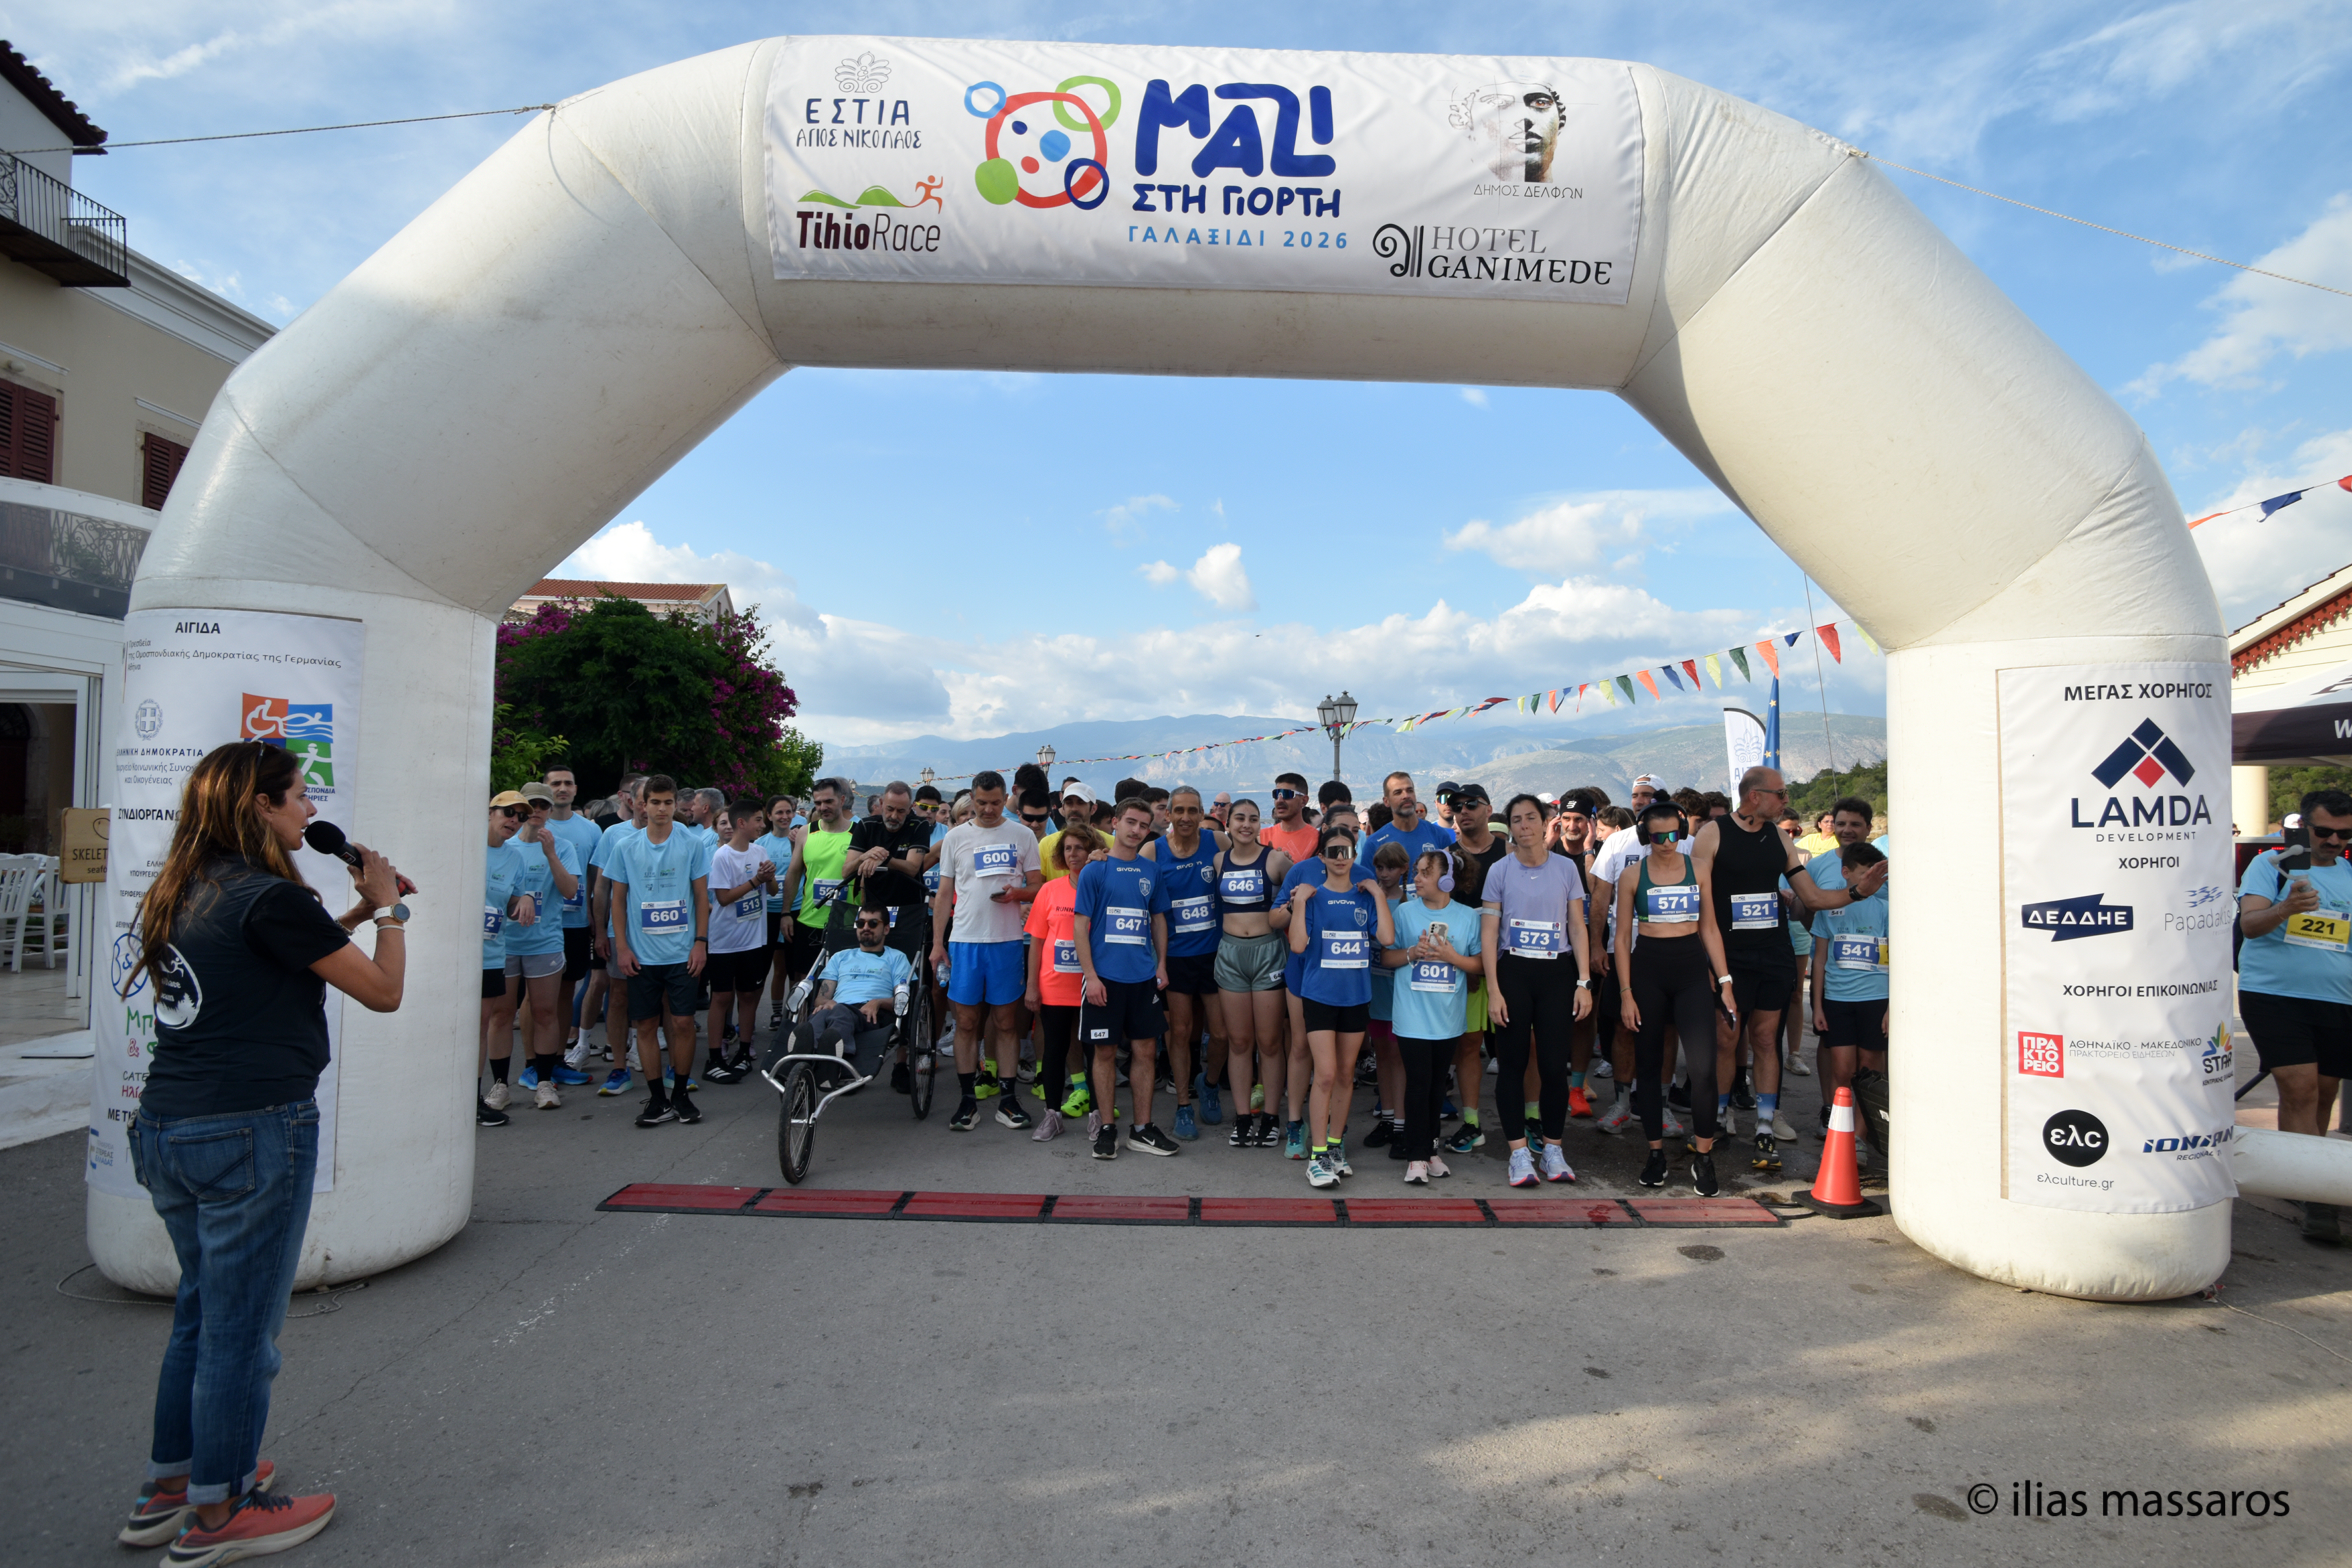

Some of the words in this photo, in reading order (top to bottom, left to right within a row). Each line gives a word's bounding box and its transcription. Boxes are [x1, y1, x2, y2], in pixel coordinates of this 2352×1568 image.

[805, 98, 910, 126] ΕΣΤΙΑ
[796, 128, 838, 147] ΑΓΙΟΣ
[844, 129, 922, 149] ΝΙΚΟΛΑΟΣ
[1473, 184, 1520, 198] ΔΗΜΟΣ
[1524, 185, 1583, 200] ΔΕΛΦΩΝ
[1131, 184, 1206, 214] ΣΤΗ
[1221, 186, 1341, 218] ΓΙΟΡΤΗ
[796, 210, 941, 252] TihioRace
[1129, 226, 1265, 246] ΓΑΛΑΞΙΔΙ
[1283, 230, 1348, 250] 2026
[1432, 226, 1547, 254] HOTEL
[1428, 255, 1612, 286] GANIMEDE
[175, 621, 221, 634] ΑΙΓΙΔΑ
[135, 649, 191, 659] Ομοσπονδιακής
[193, 649, 260, 662] Δημοκρατίας
[262, 655, 281, 663] της
[285, 654, 342, 668] Γερμανίας
[2063, 684, 2133, 701] ΜΕΓΑΣ
[2138, 682, 2213, 700] ΧΟΡΗΓΟΣ
[141, 747, 204, 757] ΔΗΜΟΚΡΑΤΙΑ
[133, 774, 173, 785] Οικογένειας
[2071, 793, 2213, 828] LAMDA
[2096, 831, 2197, 842] DEVELOPMENT
[72, 848, 109, 861] SKELET
[982, 852, 1010, 864] 600
[87, 865, 108, 874] seafo
[2118, 856, 2180, 869] ΧΟΡΗΓΟΙ
[1228, 880, 1255, 892] 646
[742, 898, 761, 911] 513
[1658, 896, 1688, 909] 571
[1742, 903, 1769, 916] 521
[651, 910, 679, 922] 660
[1182, 905, 1209, 920] 648
[2027, 909, 2128, 925] ΔΕΔΔΗΕ
[1115, 917, 1142, 931] 647
[2165, 905, 2231, 935] Papadakis
[2300, 918, 2335, 935] 221
[1519, 931, 1550, 945] 573
[1061, 949, 1078, 961] 61
[1331, 941, 1361, 955] 644
[1842, 943, 1870, 957] 541
[1420, 965, 1449, 978] 601
[2063, 984, 2132, 998] ΧΟΡΗΓΟΙ
[2136, 979, 2219, 998] ΕΠΙΚΟΙΝΩΝΙΑΣ
[2023, 1036, 2059, 1050] ΠΡΑ
[2069, 1040, 2131, 1050] ΑΘΗΝΑΪΚΟ
[2141, 1038, 2202, 1050] ΜΑΚΕΔΟΝΙΚΟ
[2023, 1048, 2059, 1061] ΚΤΟ
[2069, 1050, 2130, 1059] ΠΡΑΚΤΟΡΕΙΟ
[2132, 1050, 2175, 1059] ΕΙΔΗΣΕΩΝ
[2023, 1059, 2059, 1073] ΡΕΙΟ
[2202, 1052, 2233, 1074] STAR
[123, 1070, 150, 1082] CATE
[108, 1107, 120, 1121] ΜΕ
[2176, 1150, 2214, 1160] REGIONAL
